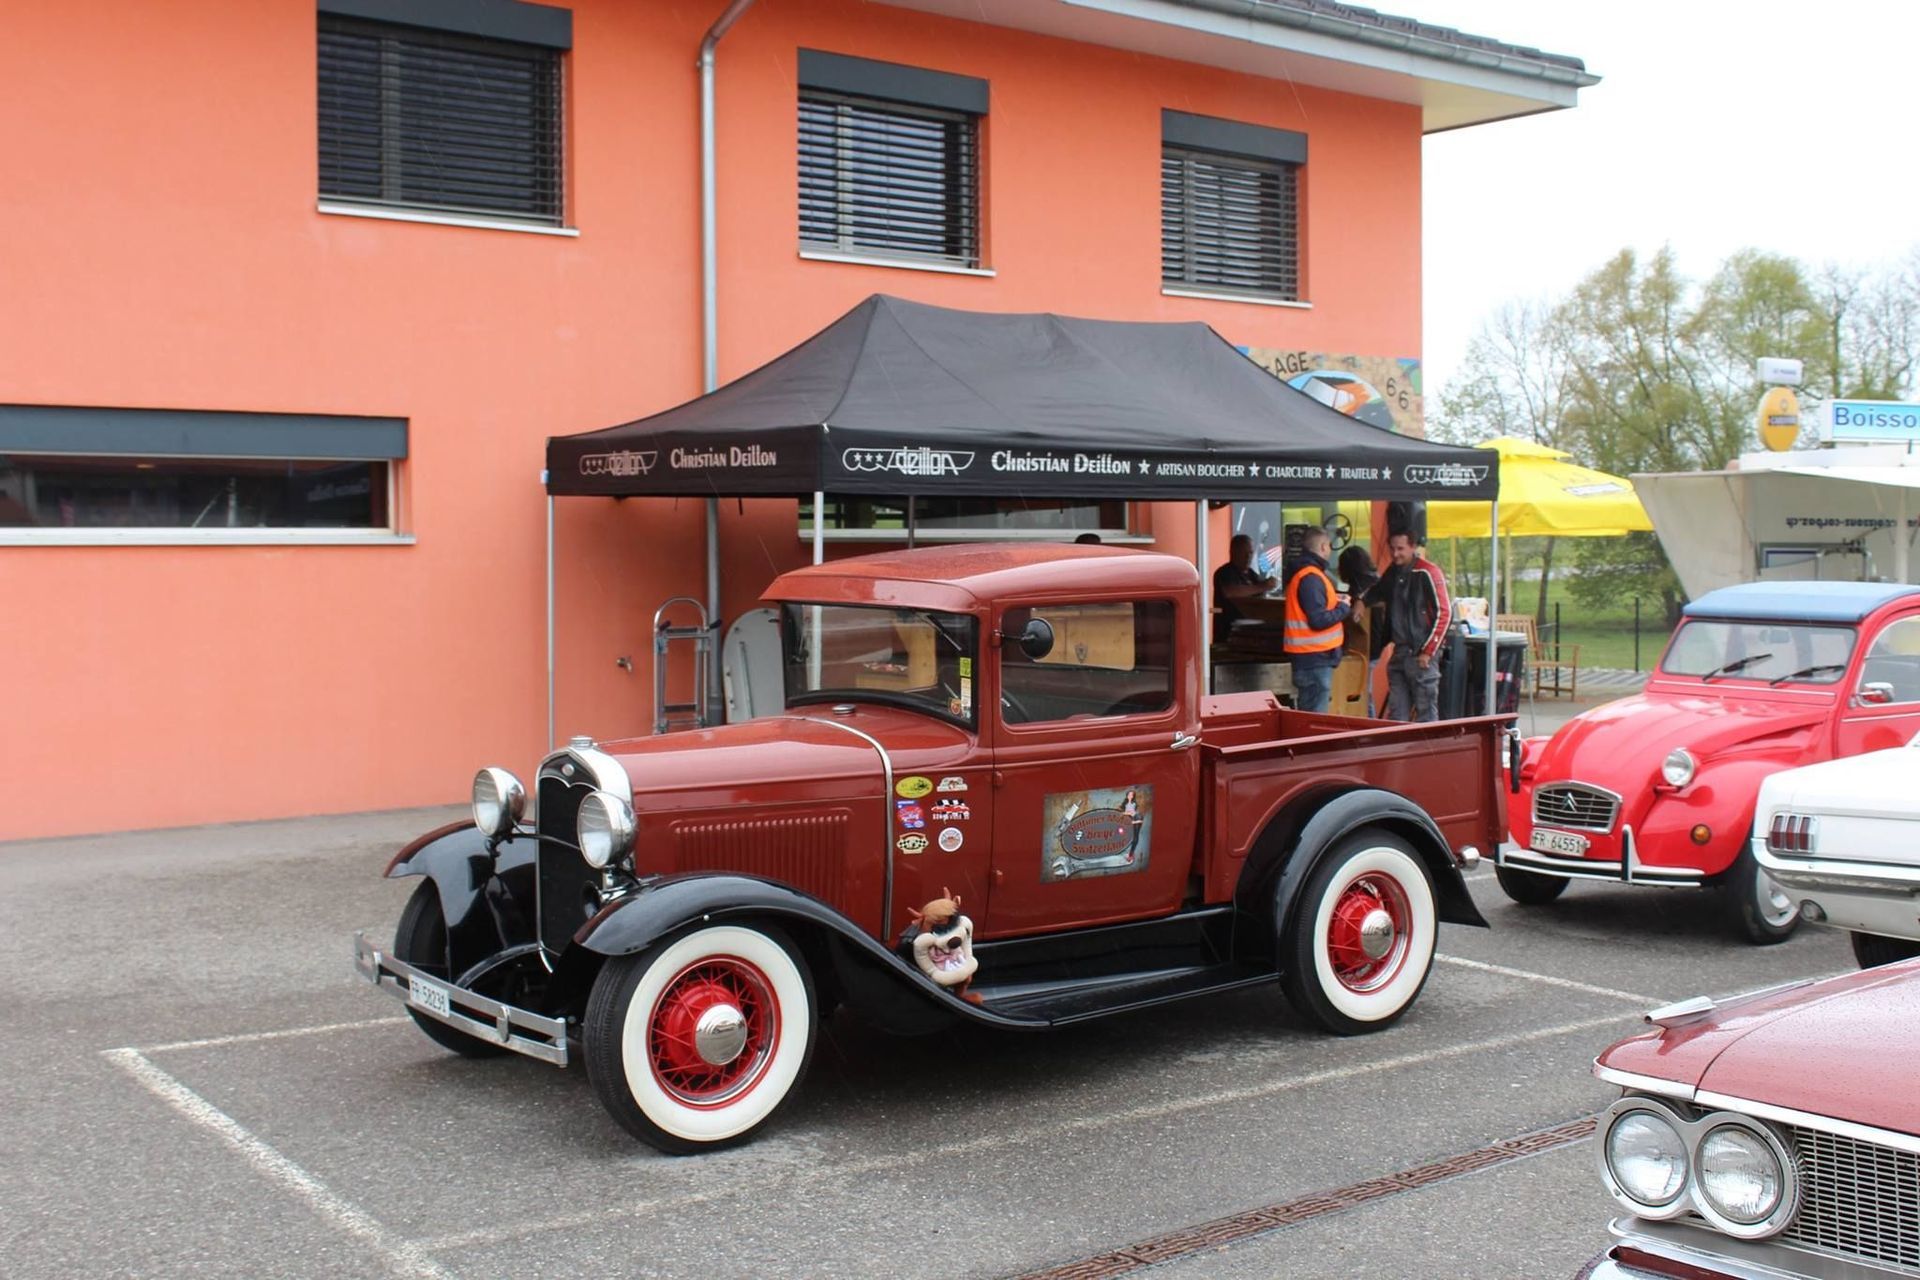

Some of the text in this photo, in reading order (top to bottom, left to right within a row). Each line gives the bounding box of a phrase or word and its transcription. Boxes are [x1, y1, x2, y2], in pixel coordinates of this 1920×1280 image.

[1264, 351, 1309, 376] AGE
[1835, 406, 1920, 429] Boisso
[1156, 463, 1196, 477] ARTISAN
[1197, 464, 1245, 478] BOUCHER
[1265, 465, 1322, 479] CHARCUTIER
[1340, 467, 1379, 481] TRAITEUR
[1533, 832, 1580, 853] FR 64551
